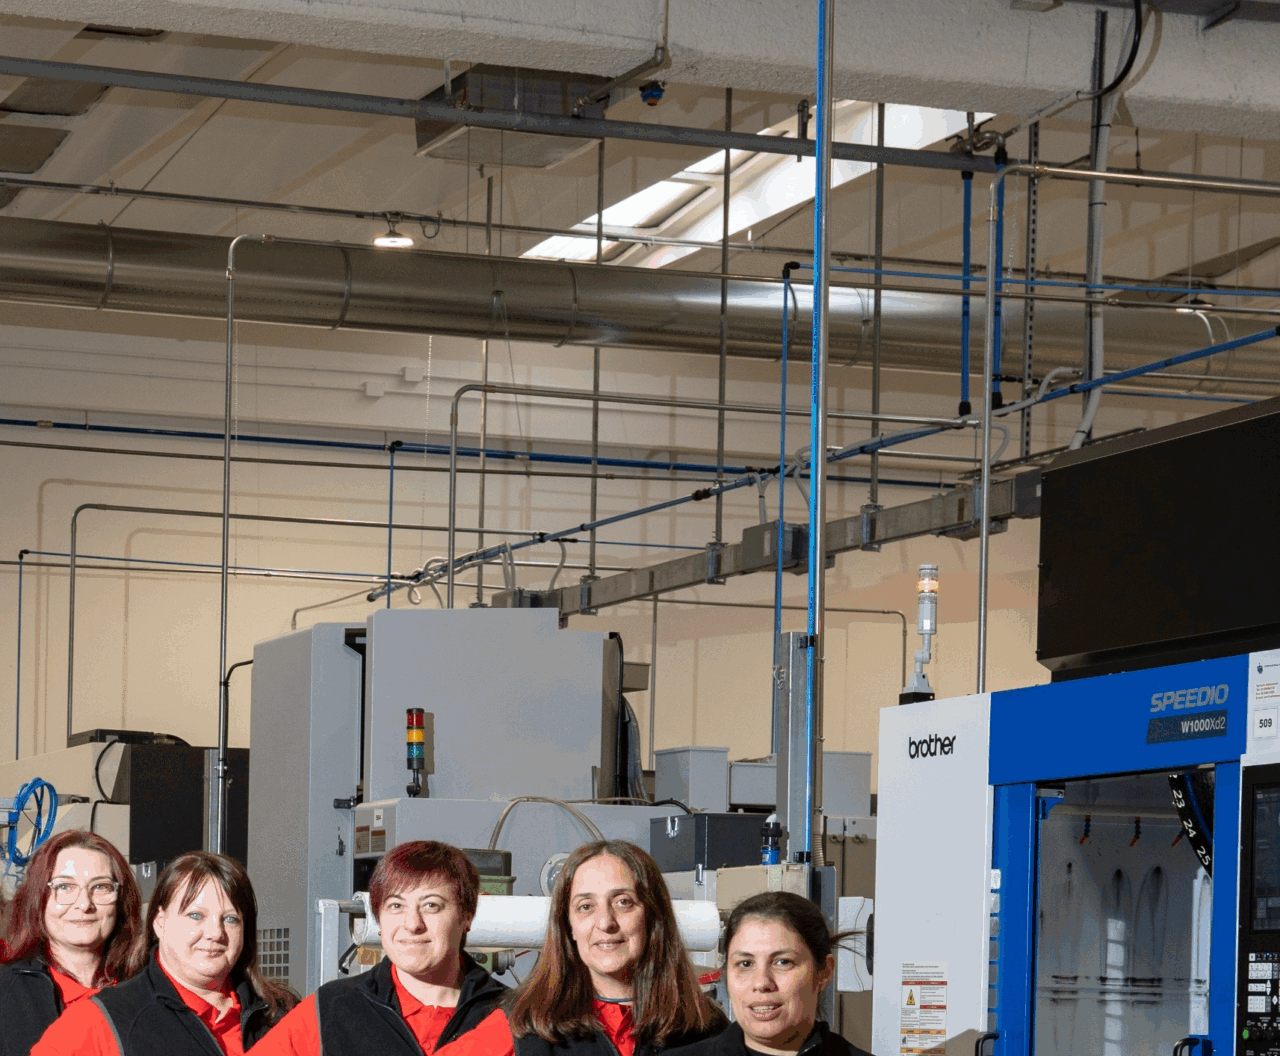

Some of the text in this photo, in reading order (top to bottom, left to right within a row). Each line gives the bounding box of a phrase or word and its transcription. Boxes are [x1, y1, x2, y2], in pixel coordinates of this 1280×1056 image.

[1150, 684, 1228, 712] SPEEDIO
[1181, 717, 1226, 733] W1000Xd2
[1259, 718, 1273, 728] 509
[909, 733, 956, 759] brother
[1172, 789, 1185, 808] 23
[1183, 819, 1196, 837] 24
[1196, 845, 1211, 865] 25
